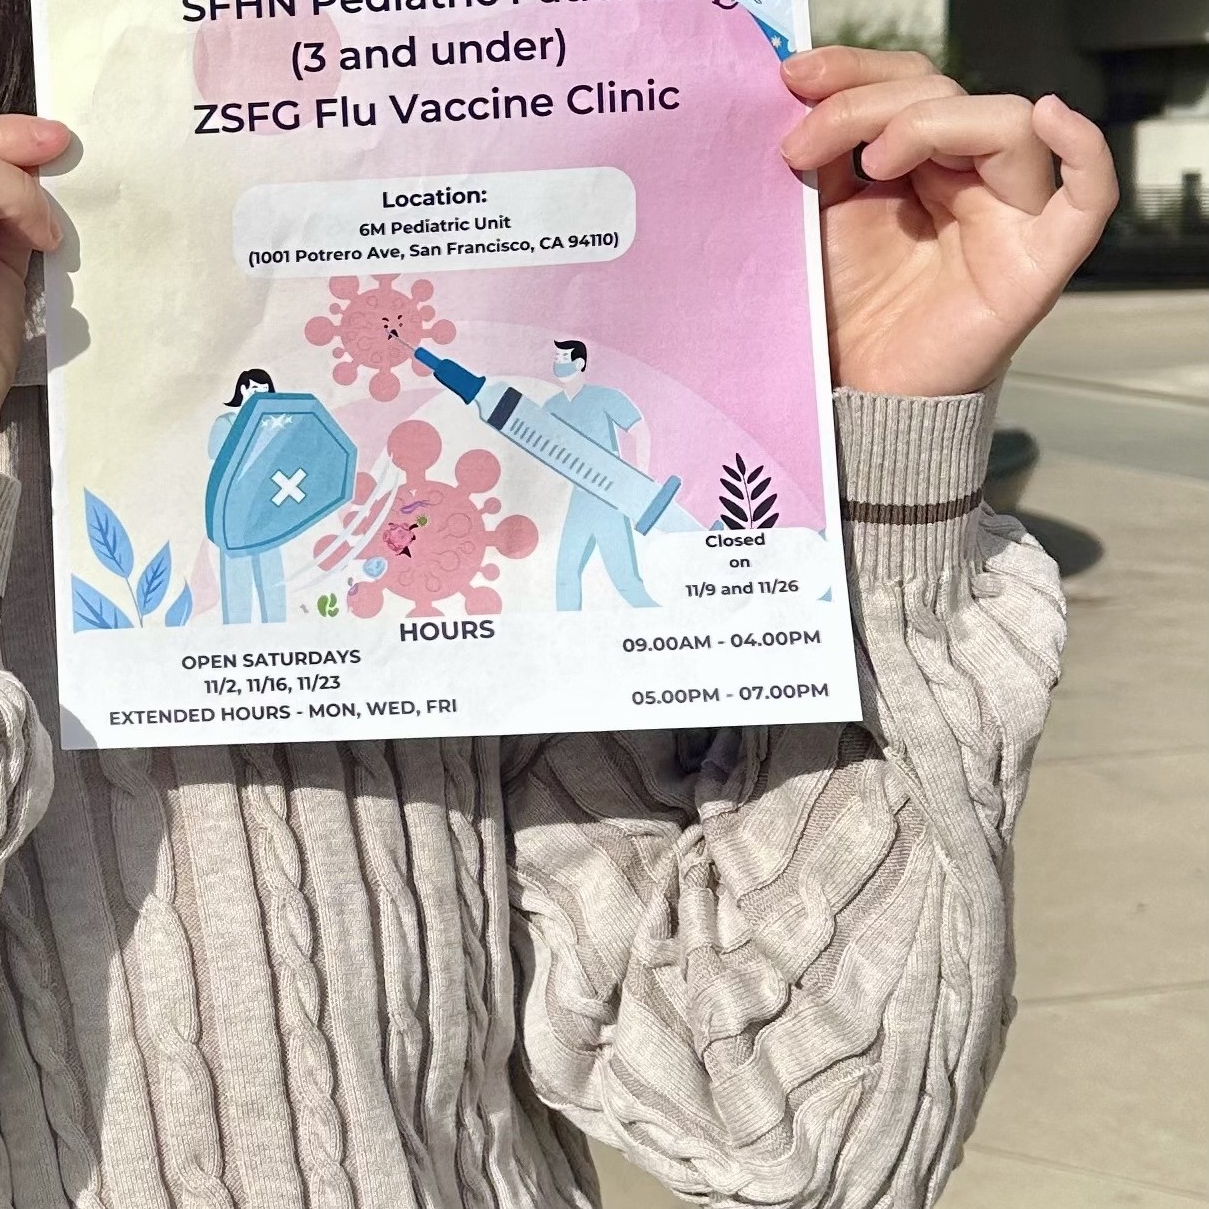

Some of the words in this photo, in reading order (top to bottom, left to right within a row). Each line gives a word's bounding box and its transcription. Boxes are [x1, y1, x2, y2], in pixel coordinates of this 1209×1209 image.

[292, 41, 326, 81] (3
[339, 35, 417, 71] and
[431, 27, 566, 68] under)
[193, 99, 301, 135] ZSFG
[315, 95, 377, 129] Flu
[388, 86, 554, 125] Vaccine
[566, 78, 680, 115] Clinic
[382, 186, 487, 209] Location:
[359, 222, 386, 237] 6M
[391, 216, 470, 235] Pediatric
[474, 214, 512, 231] Unit
[248, 250, 290, 268] (1001
[295, 249, 363, 263] Potrero
[366, 246, 405, 261] Ave,
[409, 243, 442, 258] San
[446, 238, 535, 256] Francisco,
[539, 236, 565, 250] CA
[567, 231, 619, 249] 94110)
[705, 532, 766, 548] Closed
[729, 558, 751, 569] on
[684, 581, 716, 599] 11/9
[720, 581, 754, 596] and
[757, 578, 799, 595] 11/26
[399, 619, 495, 642] HOURS
[622, 634, 712, 653] 09.00AM
[730, 629, 821, 648] 04.00PM
[181, 653, 237, 670] OPEN
[242, 649, 362, 668] SATURDAYS
[203, 676, 242, 696] 11/2,
[245, 675, 293, 695] 11/16,
[296, 673, 341, 693] 11/23
[631, 687, 720, 706] 05.00PM
[738, 682, 830, 701] 07.00PM
[109, 707, 216, 726] EXTENDED
[220, 704, 291, 722] HOURS
[308, 702, 362, 720] MON,
[365, 700, 421, 717] WED,
[426, 698, 457, 714] FRI
